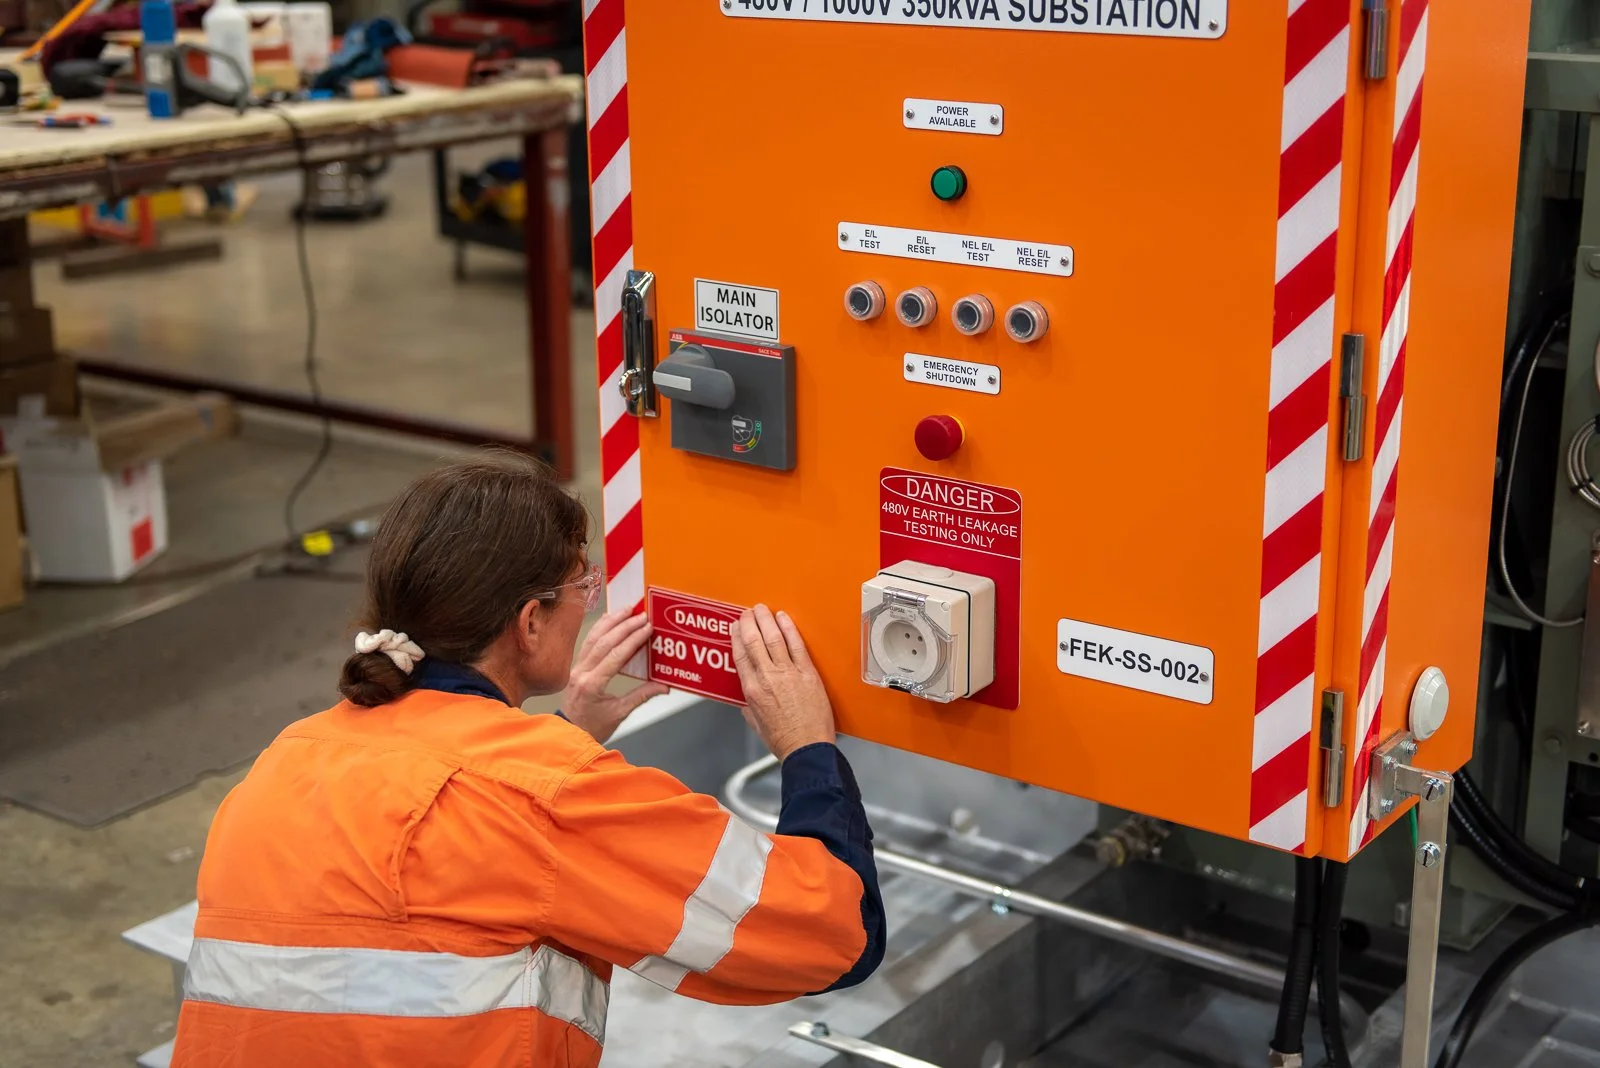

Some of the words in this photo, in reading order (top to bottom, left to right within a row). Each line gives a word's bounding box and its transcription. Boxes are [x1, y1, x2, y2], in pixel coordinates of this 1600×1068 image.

[1008, 0, 1199, 29] SUBSTATION
[936, 105, 969, 116] POWER
[928, 116, 976, 128] AVAILABLE
[864, 229, 878, 239] E/L
[916, 235, 929, 245] E/L
[859, 239, 881, 249] TEST
[907, 244, 936, 255] RESET
[962, 240, 979, 250] NEL
[981, 242, 995, 252] E/L
[967, 251, 990, 262] TEST
[1016, 247, 1035, 257] NEL
[1037, 249, 1051, 259] E/L
[1018, 257, 1049, 268] RESET
[717, 287, 756, 308] MAIN
[701, 306, 774, 332] ISOLATOR
[923, 360, 979, 376] EMERGENCY
[926, 371, 976, 387] SHUTDOWN
[906, 477, 995, 513] DANGER
[881, 501, 910, 516] 480V
[912, 507, 954, 526] EARTH
[958, 516, 1018, 538] LEAKAGE
[904, 520, 958, 541] TESTING
[961, 531, 995, 548] ONLY
[675, 609, 734, 636] DANGE
[652, 636, 687, 661] 480
[692, 643, 737, 674] VOL
[1070, 637, 1199, 684] FEK-SS-002
[655, 663, 673, 675] FED
